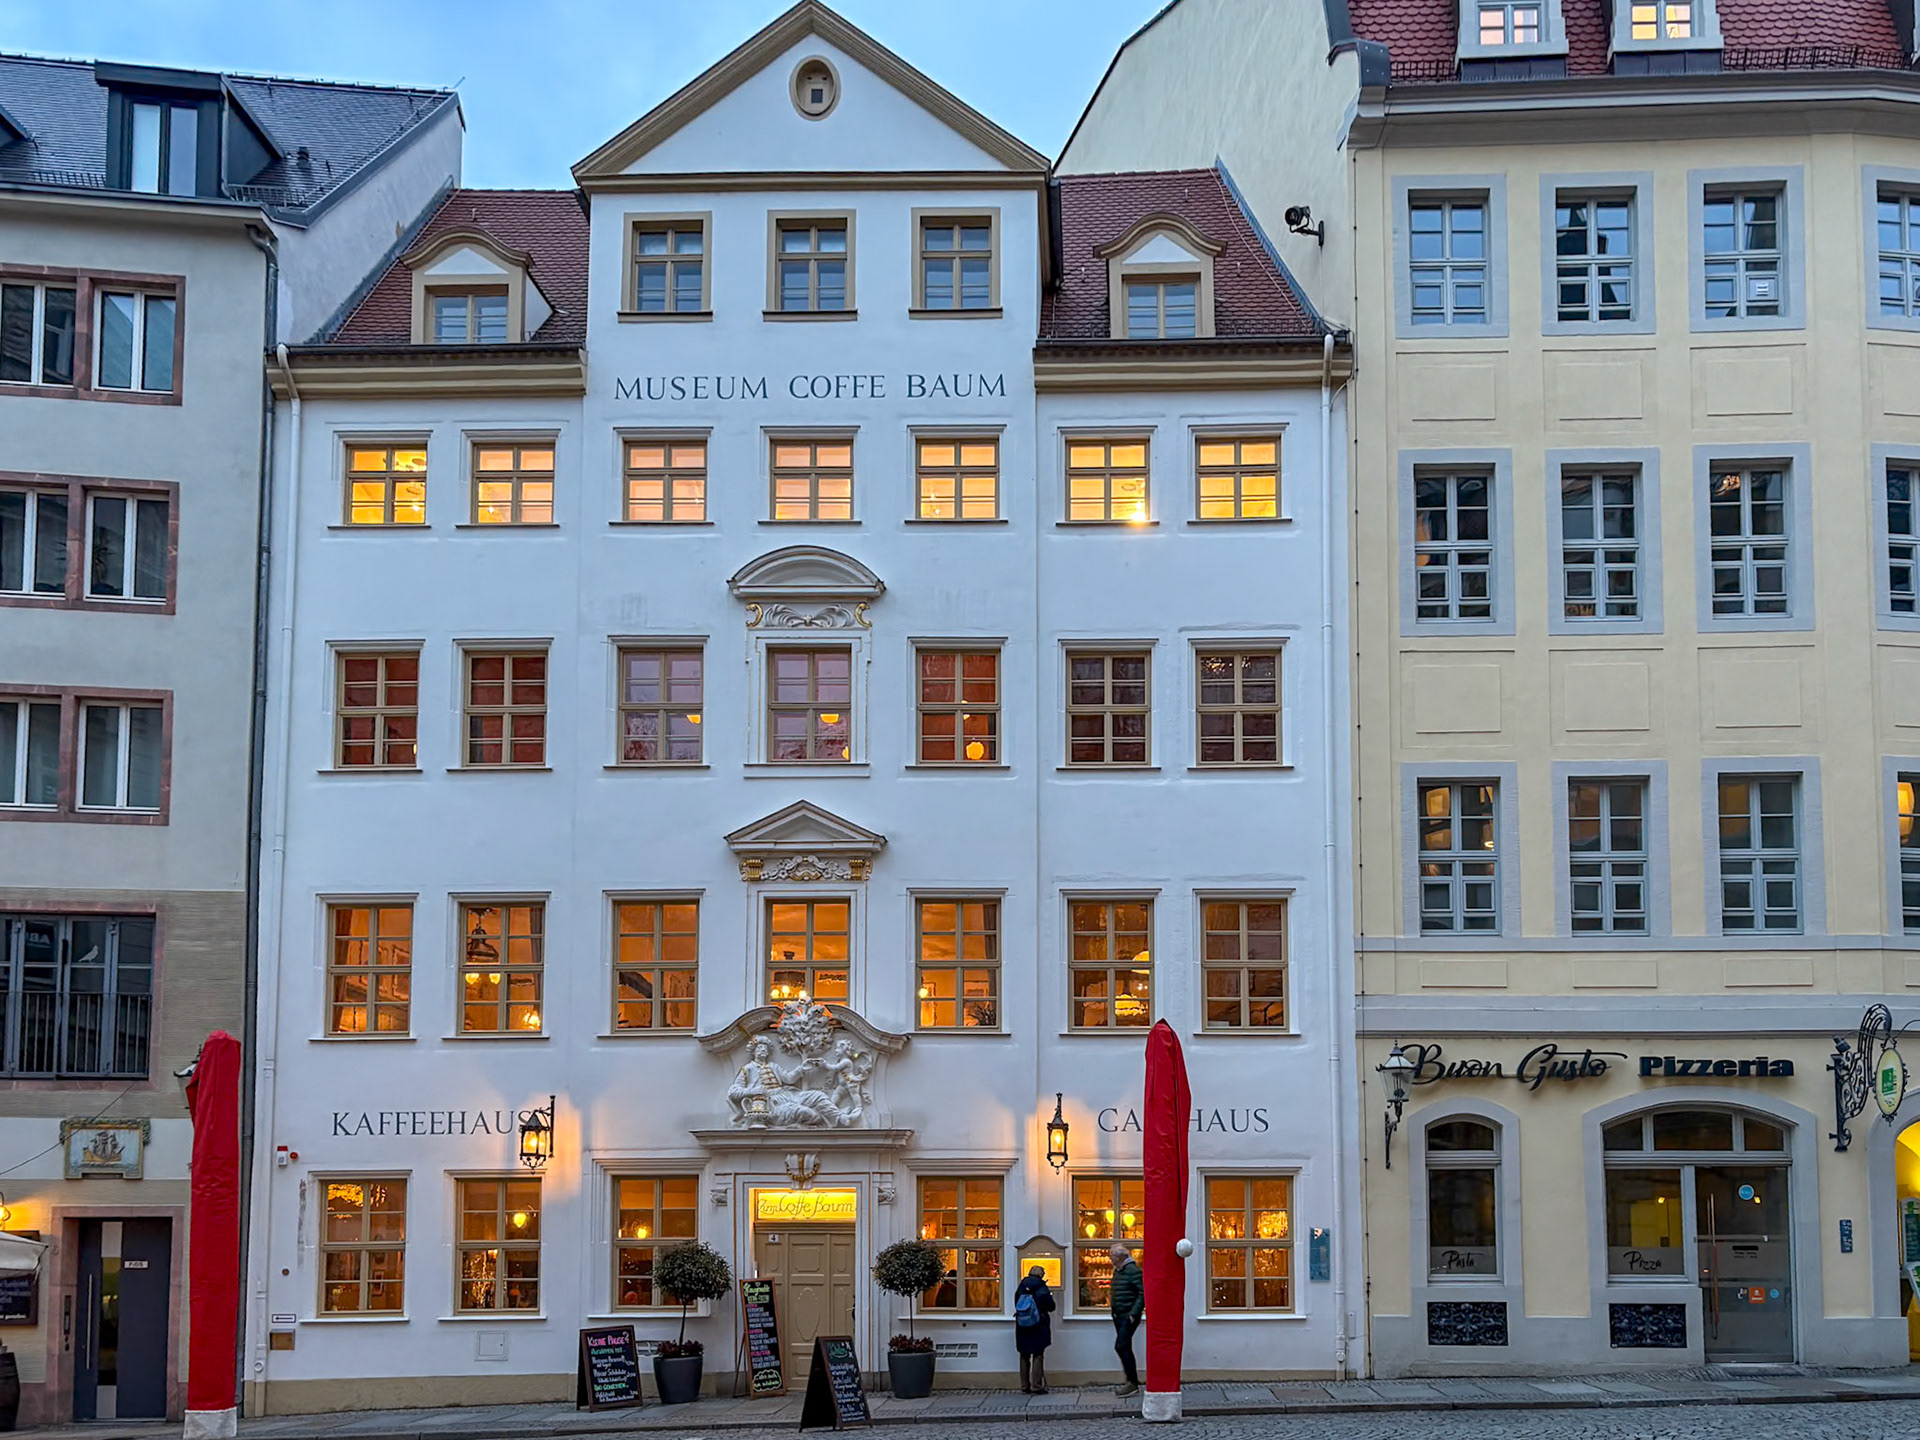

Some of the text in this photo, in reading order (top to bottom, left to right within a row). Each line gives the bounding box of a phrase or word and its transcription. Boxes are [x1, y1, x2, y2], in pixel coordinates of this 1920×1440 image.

[614, 373, 1007, 400] MUSEUM COFFE BAUM
[1401, 1043, 1795, 1091] Buon Gusto Pizzeria
[1097, 1108, 1270, 1133] GAHAUS
[780, 1195, 811, 1216] Coffe
[1442, 1250, 1484, 1269] Pasta
[1623, 1250, 1662, 1270] Pizza
